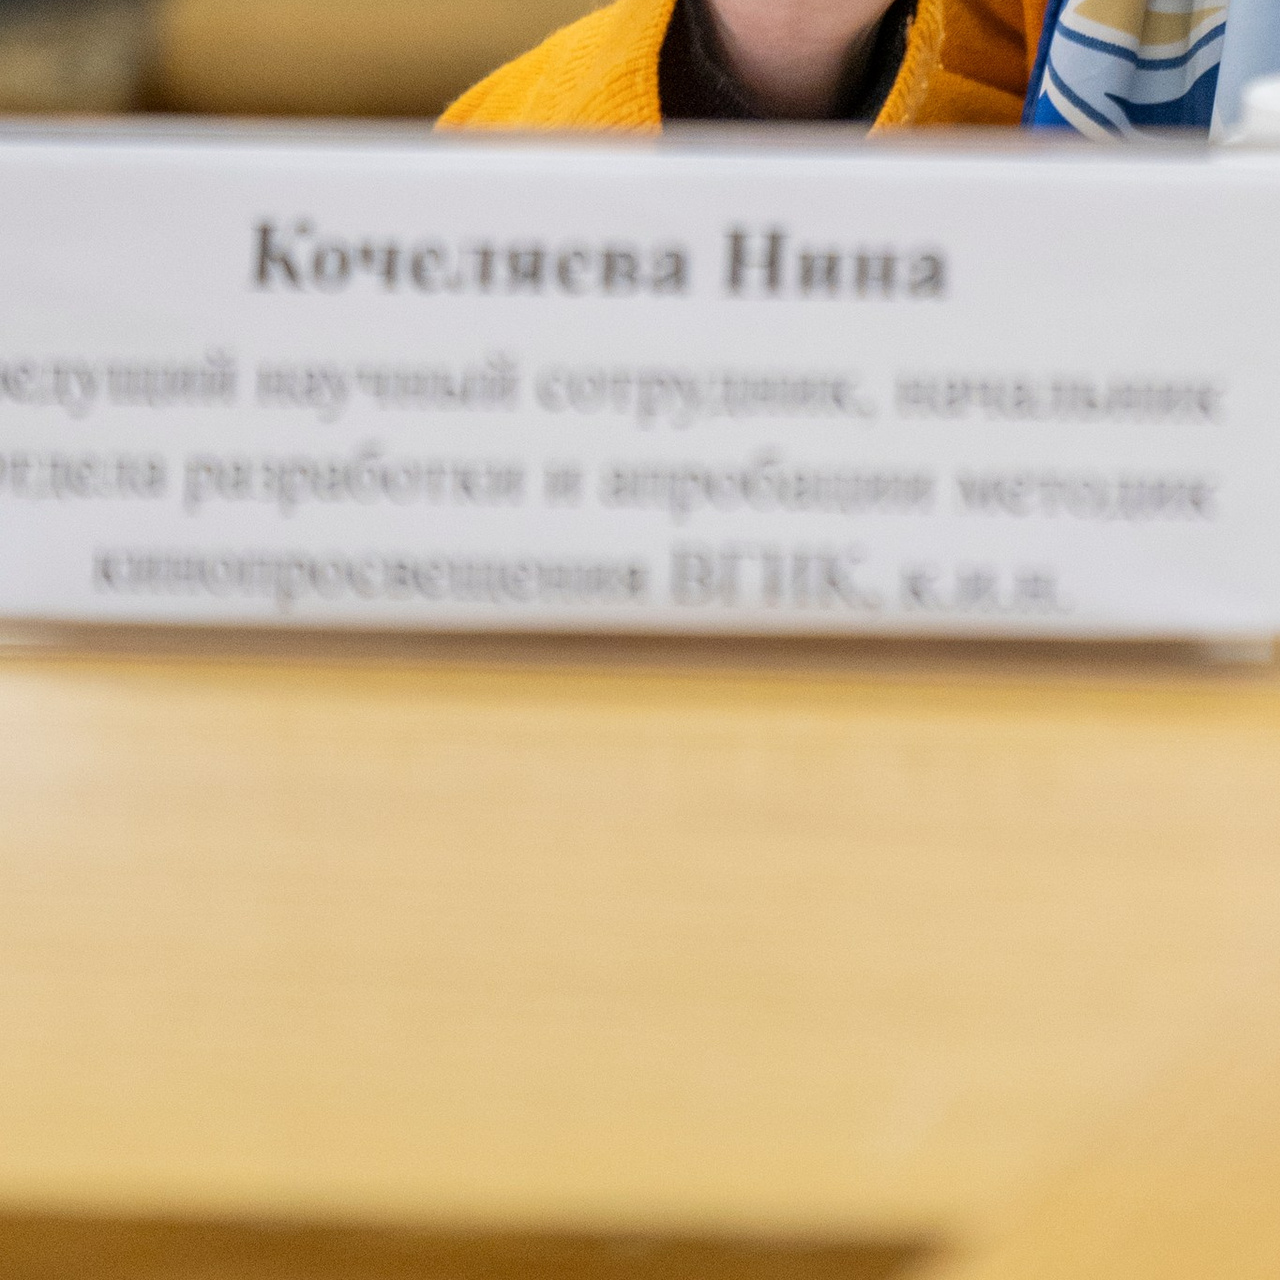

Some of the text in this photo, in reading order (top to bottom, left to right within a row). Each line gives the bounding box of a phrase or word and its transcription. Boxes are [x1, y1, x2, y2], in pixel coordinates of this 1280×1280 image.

[249, 215, 950, 301] Кочеляева Нина
[0, 348, 238, 420] едущий
[255, 352, 519, 424] научный
[0, 451, 168, 502] тдела
[182, 439, 527, 519] разработки
[542, 457, 586, 508] и
